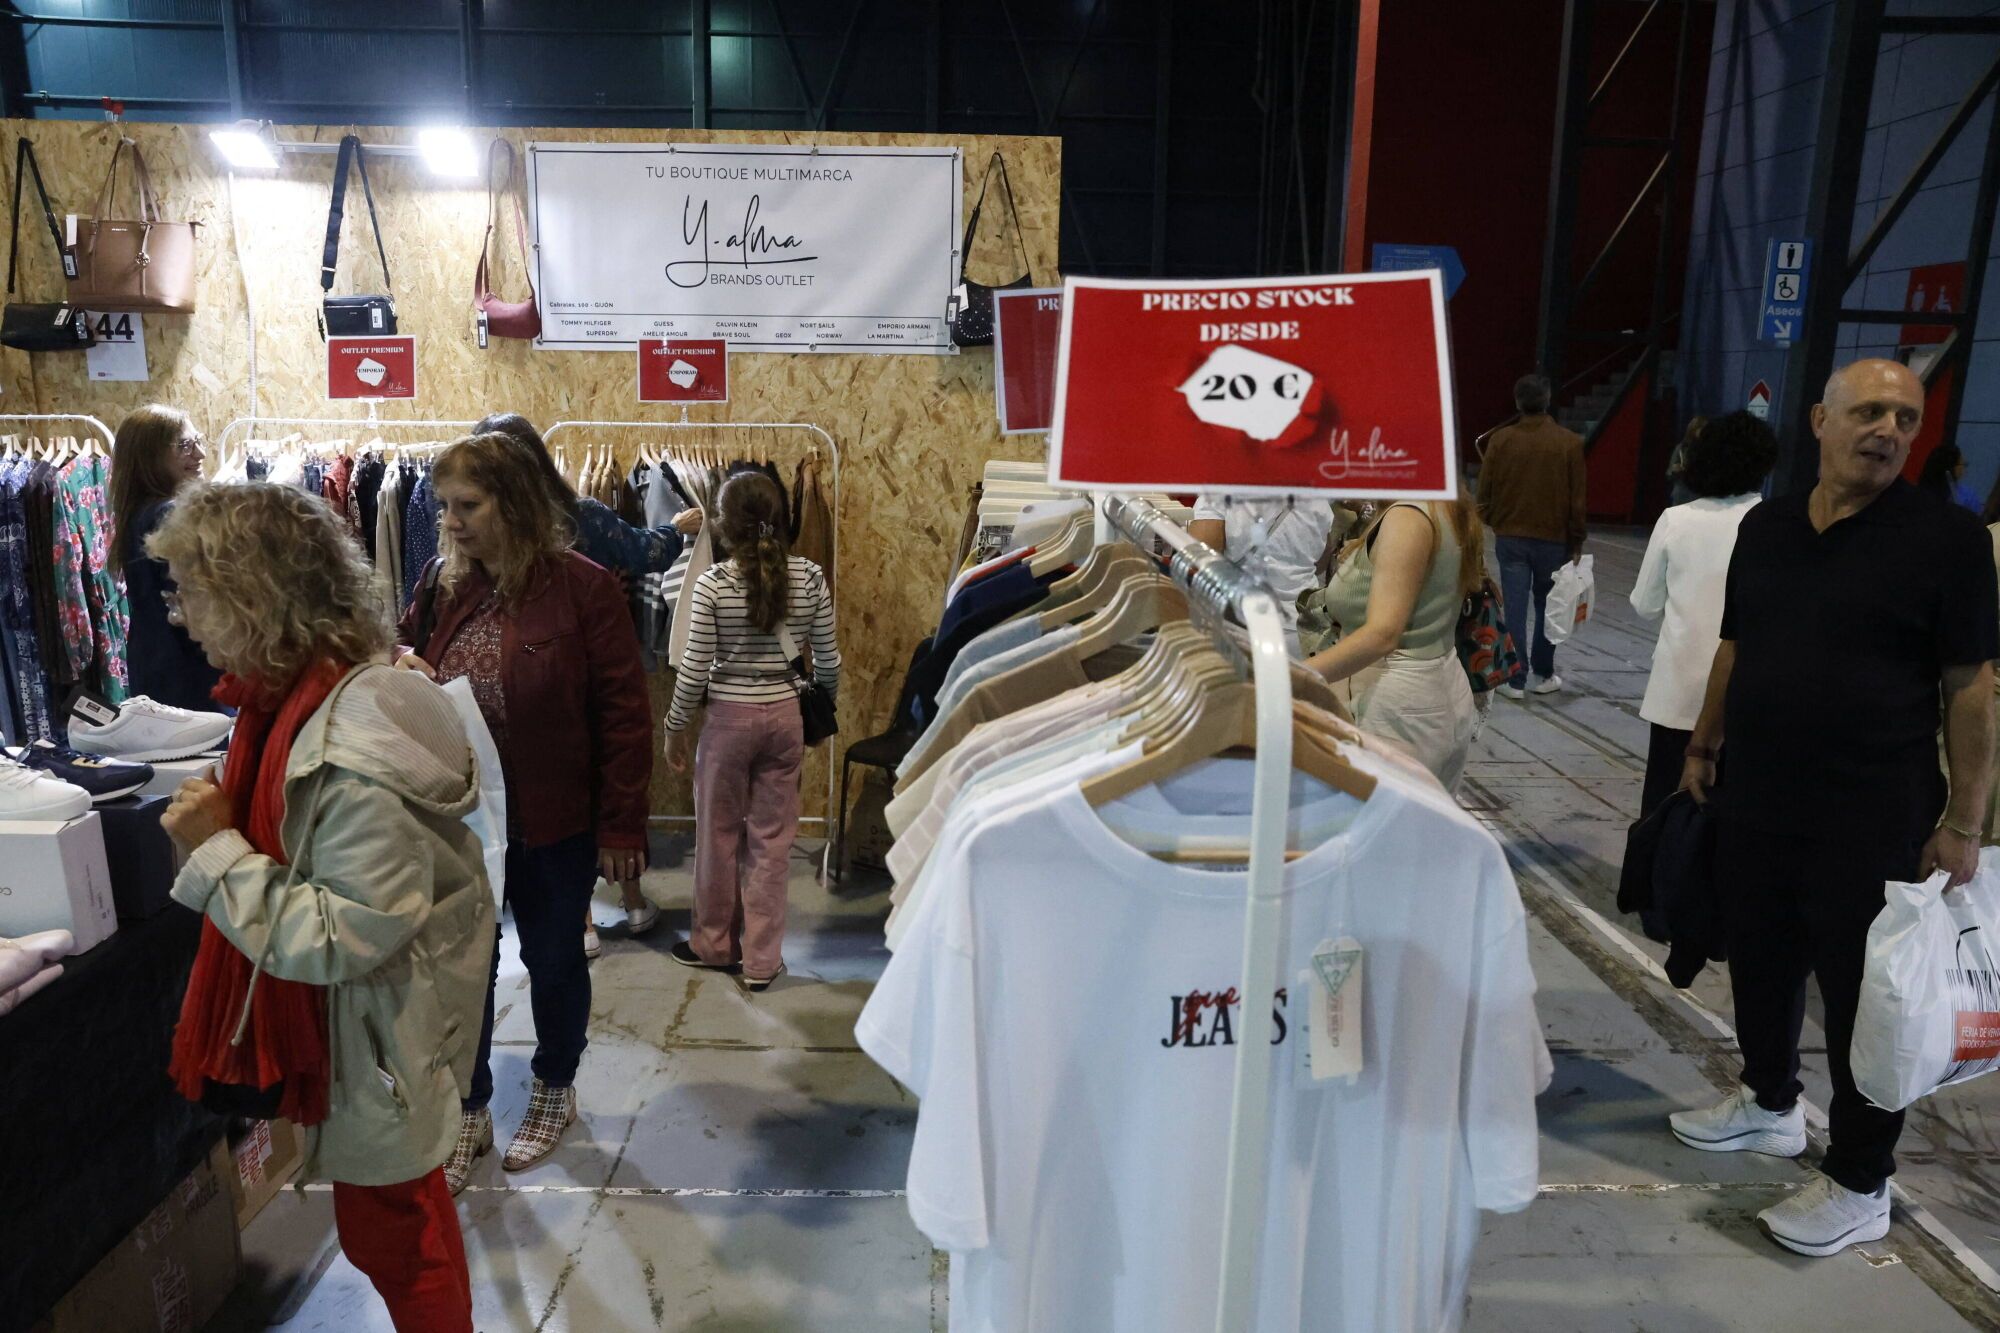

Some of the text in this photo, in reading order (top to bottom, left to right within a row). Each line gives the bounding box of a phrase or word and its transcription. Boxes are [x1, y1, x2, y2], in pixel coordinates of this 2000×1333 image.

[645, 166, 853, 182] TU BOUTIQUE MULTIMARCA
[710, 273, 815, 286] BRANDS OUTLET
[1038, 297, 1059, 311] PR
[1142, 287, 1355, 311] PRECIO STOCK
[1200, 321, 1300, 342] DESDE
[1201, 374, 1257, 401] 20
[1161, 988, 1288, 1048] JEAS
